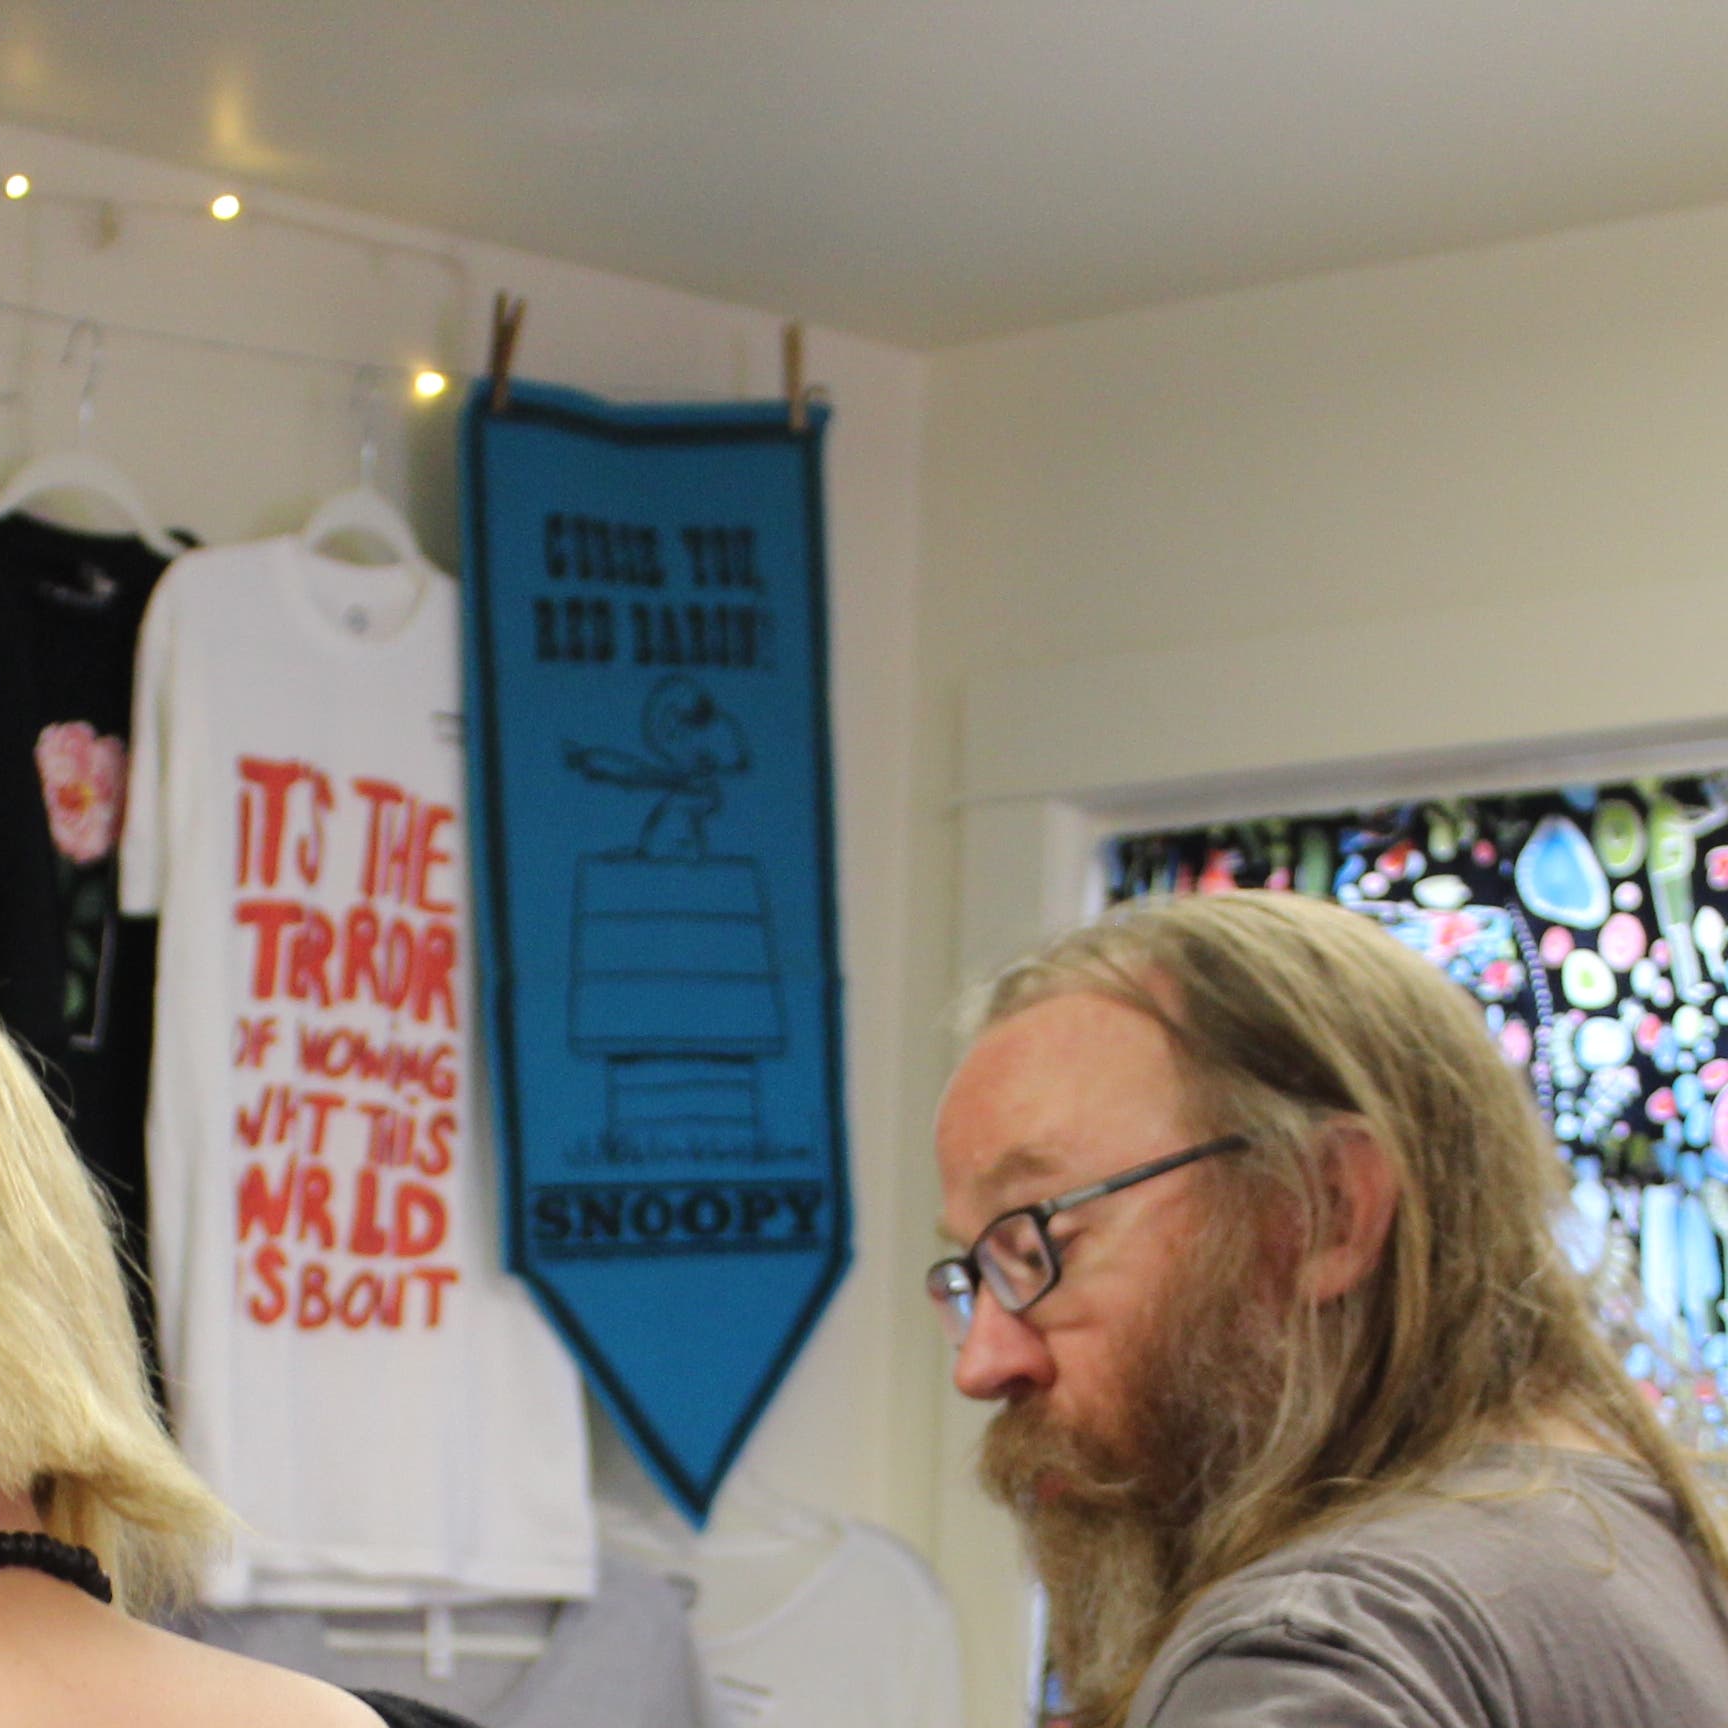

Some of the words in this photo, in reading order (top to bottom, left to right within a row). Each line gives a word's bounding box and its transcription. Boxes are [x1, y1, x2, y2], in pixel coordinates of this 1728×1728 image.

[353, 776, 458, 914] THE
[236, 1155, 449, 1258] WRLD
[533, 1187, 829, 1242] SNOOPY
[296, 1262, 460, 1330] BOUT
